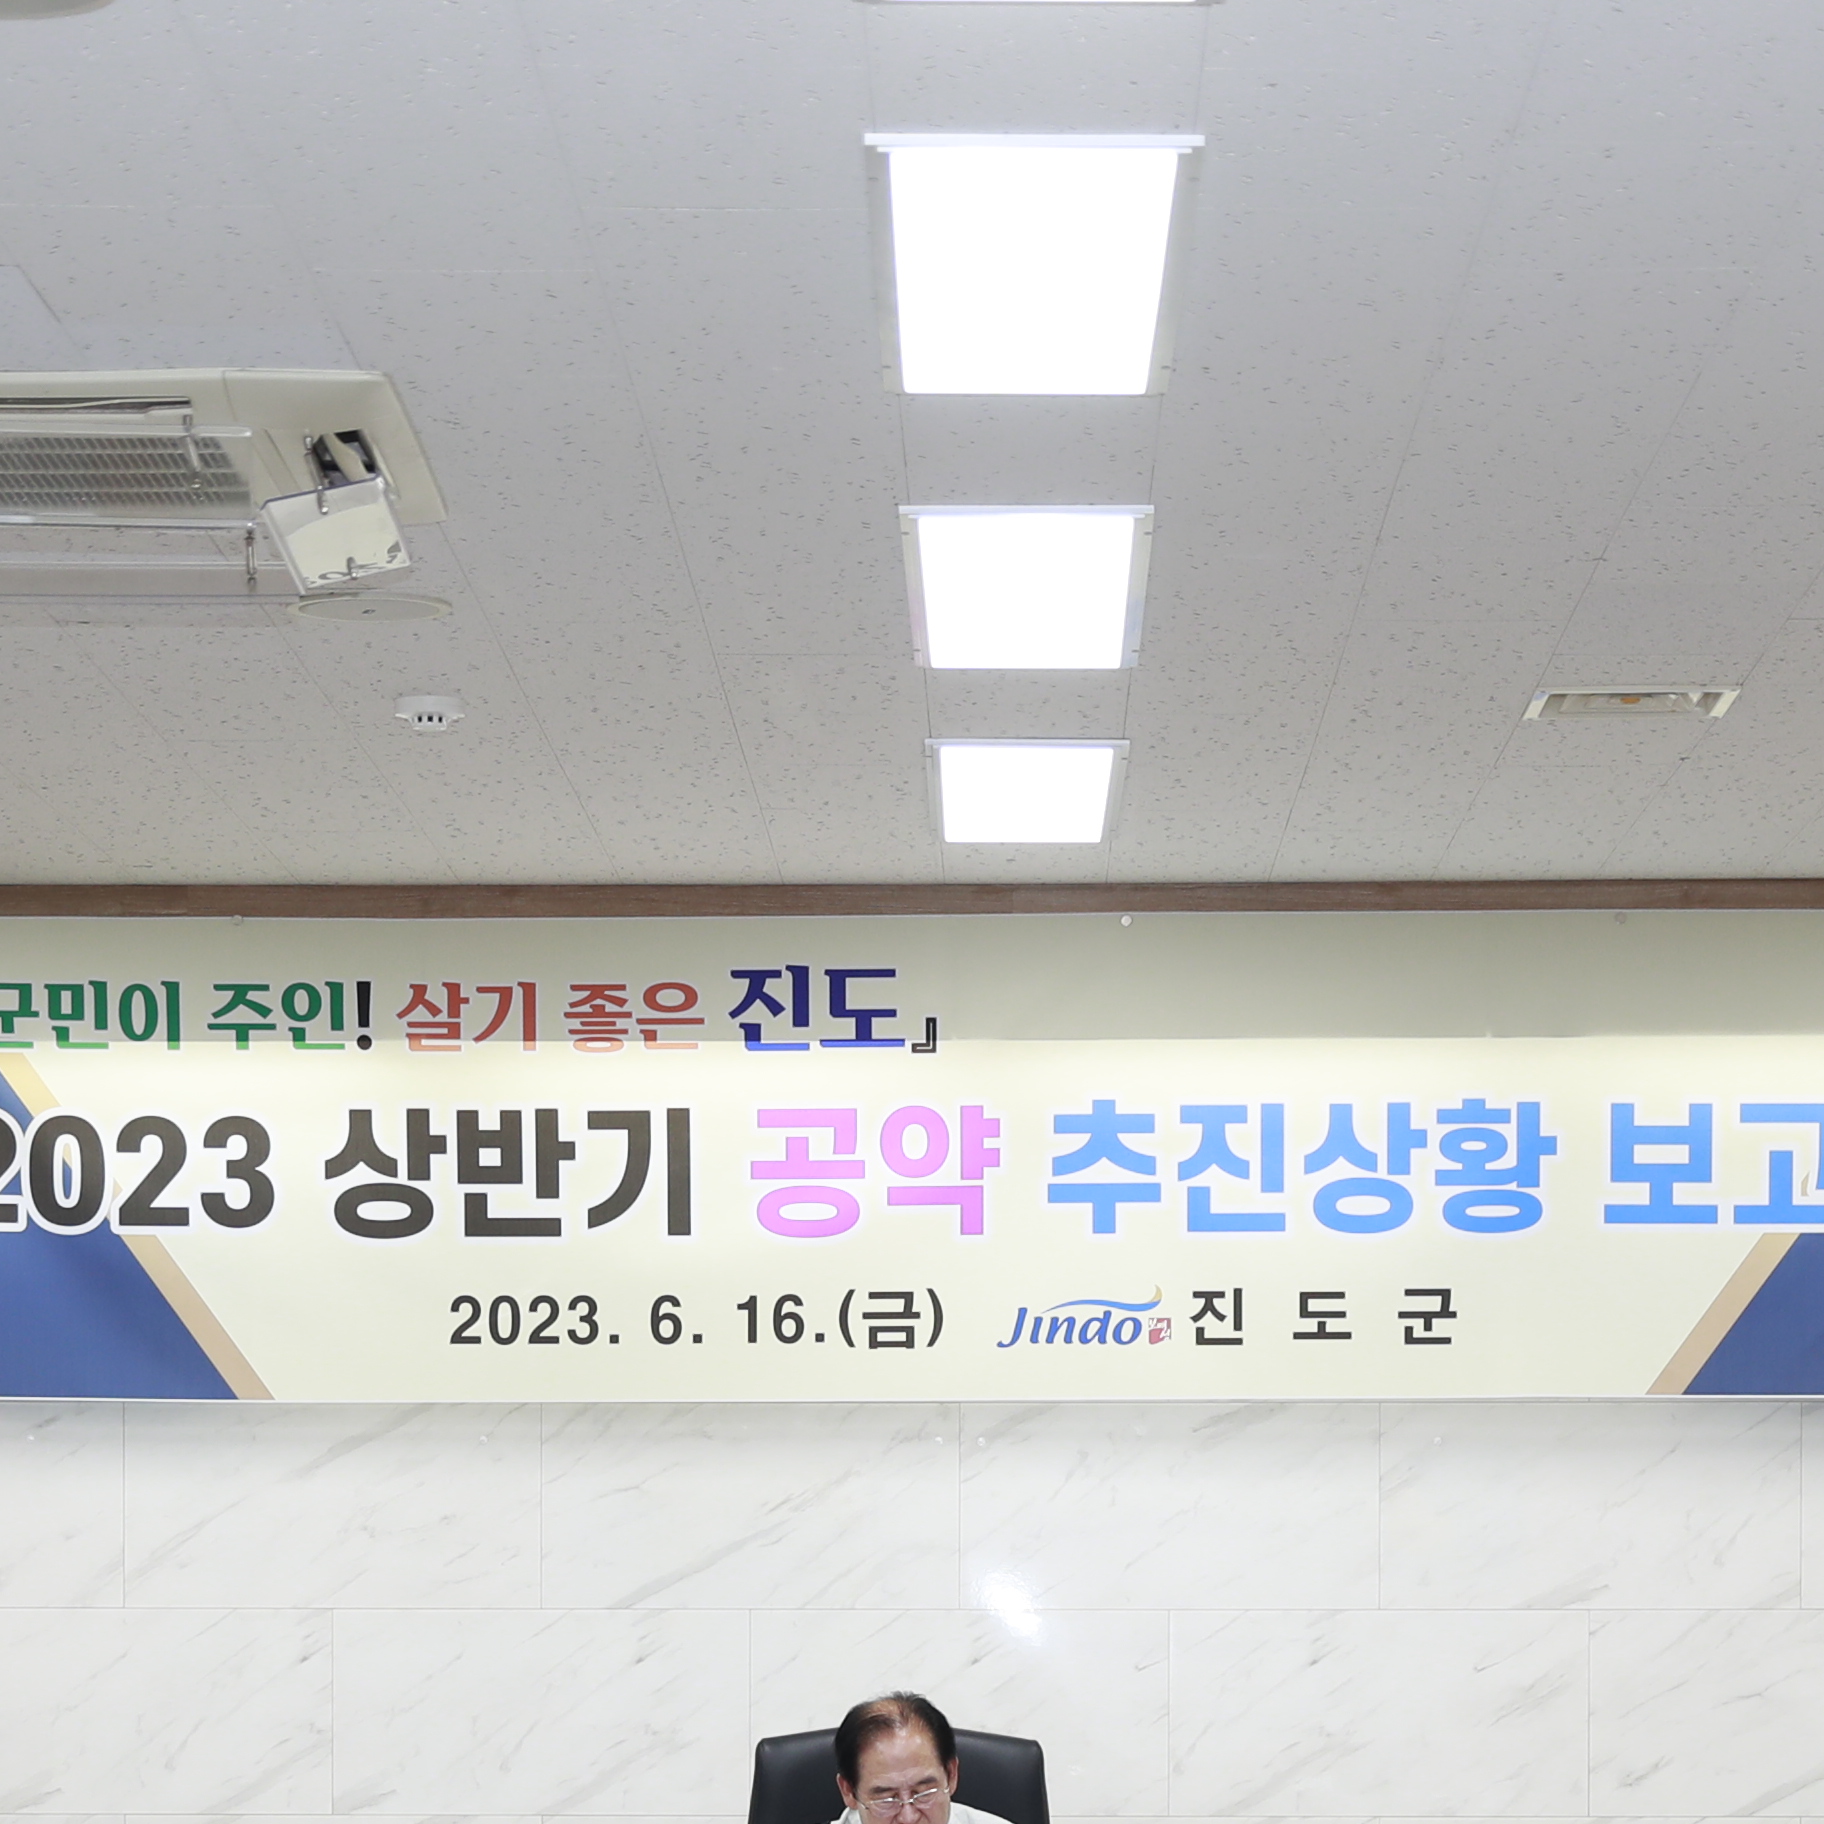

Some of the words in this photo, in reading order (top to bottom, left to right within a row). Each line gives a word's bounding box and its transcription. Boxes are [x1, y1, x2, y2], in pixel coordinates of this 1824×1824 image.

[206, 980, 373, 1051] 주인!
[394, 980, 538, 1052] 살기
[562, 980, 706, 1052] 좋은
[727, 964, 937, 1054] 진도』
[324, 1108, 692, 1238] 상반기
[750, 1105, 1001, 1238] 공약
[1047, 1098, 1558, 1234] 추진상황
[450, 1295, 620, 1346] 2023.
[649, 1295, 704, 1346] 6.
[737, 1290, 945, 1352] 16.(금)
[996, 1307, 1141, 1347] Jindo
